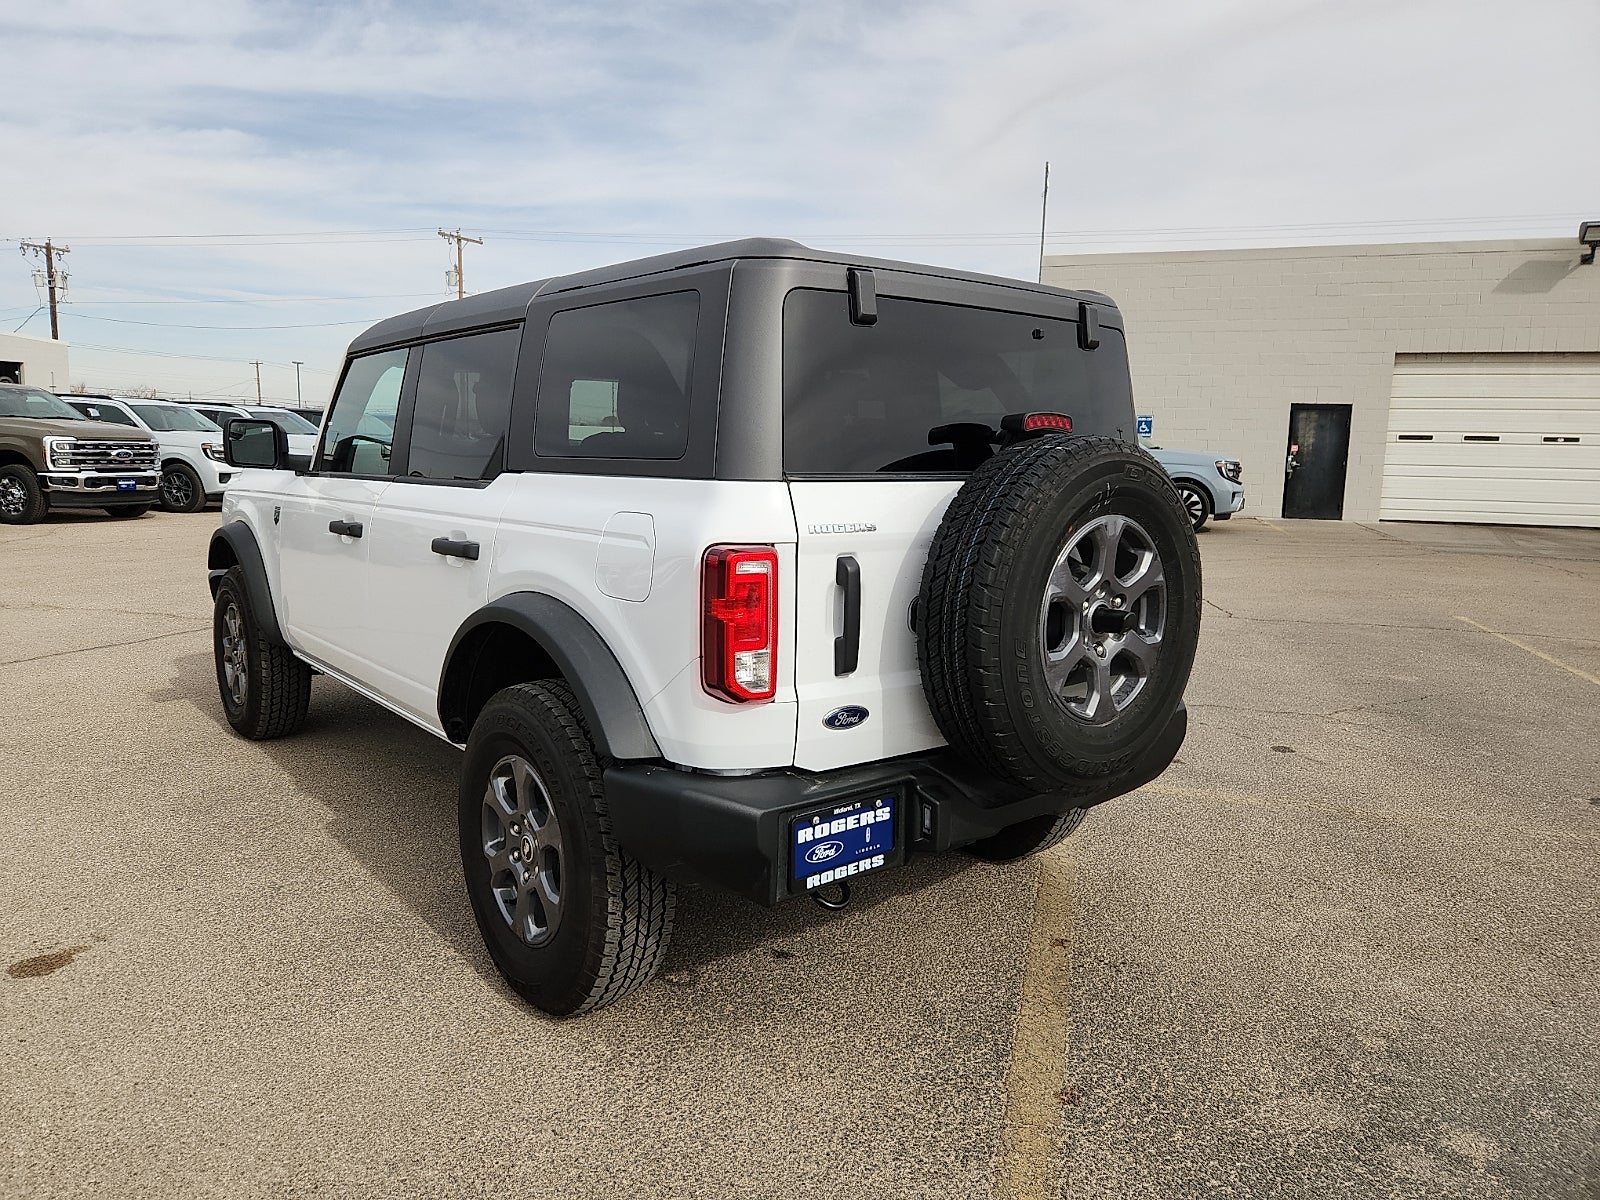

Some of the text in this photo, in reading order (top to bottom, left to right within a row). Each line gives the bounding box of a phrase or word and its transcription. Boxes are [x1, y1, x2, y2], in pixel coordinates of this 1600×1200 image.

[808, 523, 877, 535] ROGERS
[834, 711, 861, 726] Ford
[798, 807, 890, 844] ROGERS
[812, 843, 837, 861] Ford
[806, 853, 885, 890] ROGERS
